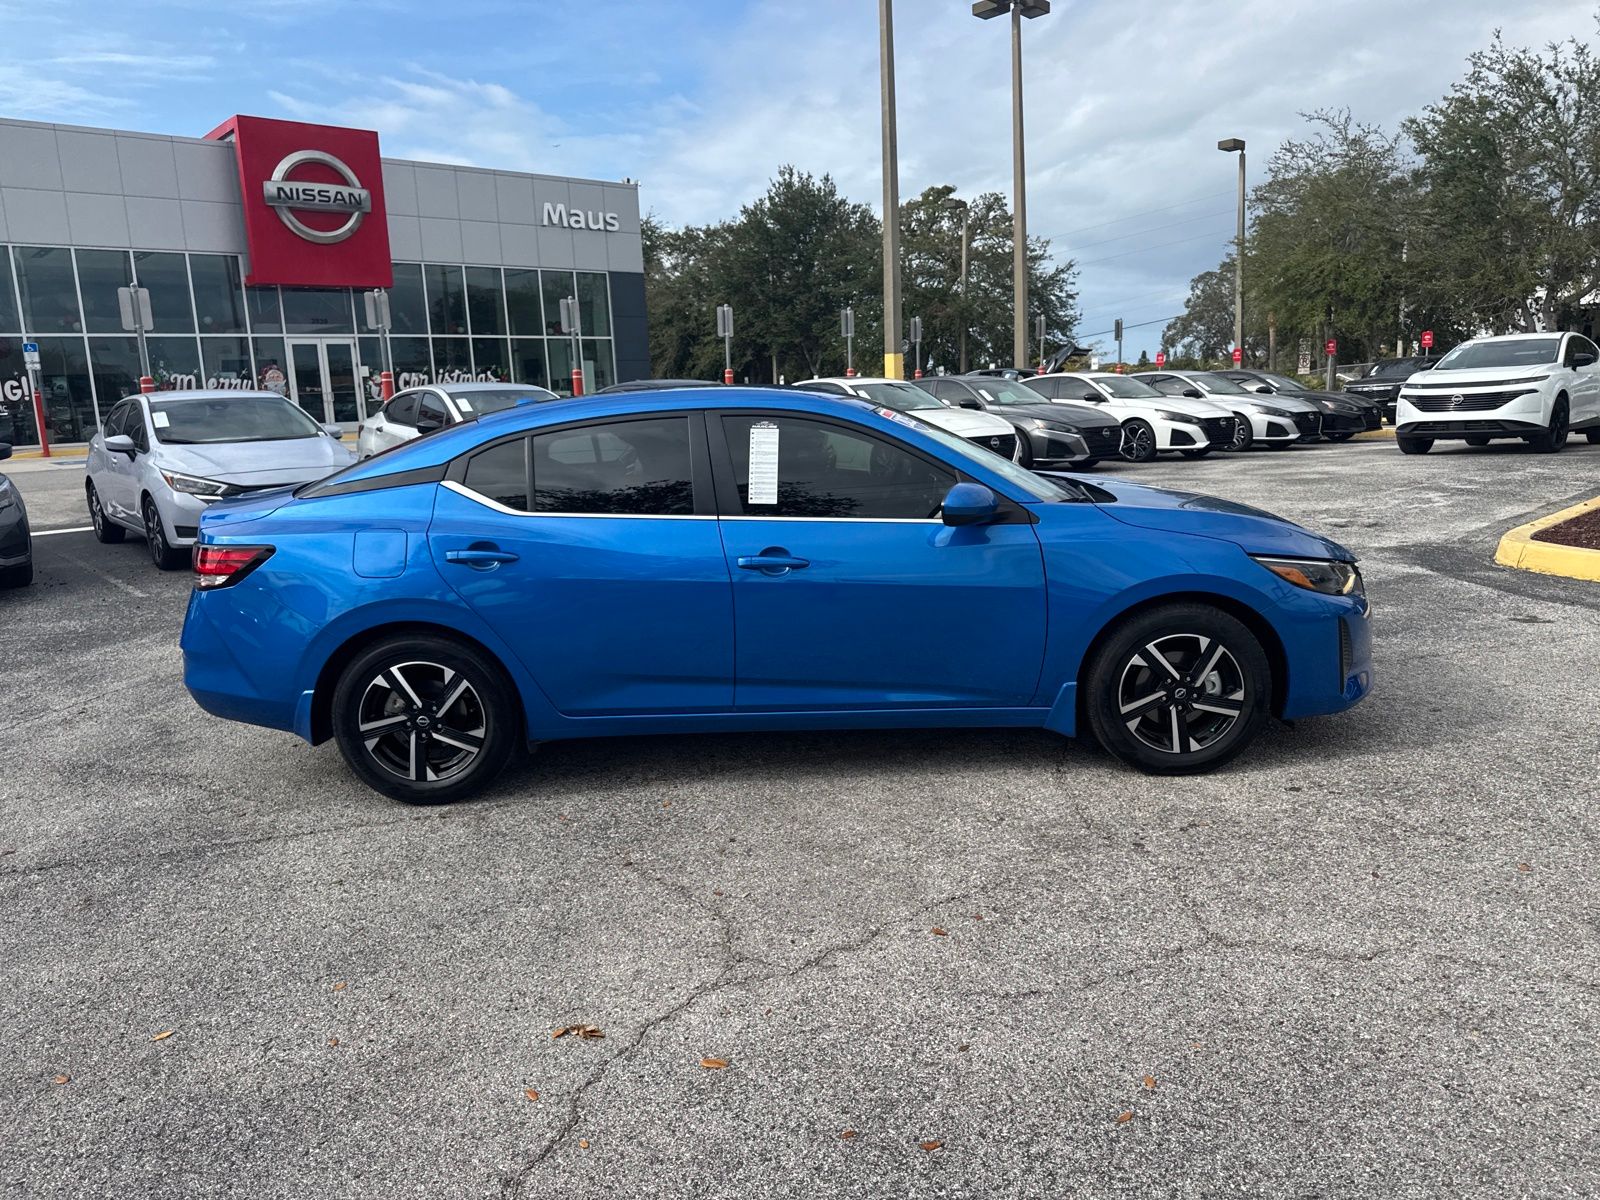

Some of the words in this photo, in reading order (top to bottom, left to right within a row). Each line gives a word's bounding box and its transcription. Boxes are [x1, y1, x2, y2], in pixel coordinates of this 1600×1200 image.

[276, 186, 363, 206] NISSAN
[542, 202, 620, 231] Maus
[0, 375, 30, 401] G!
